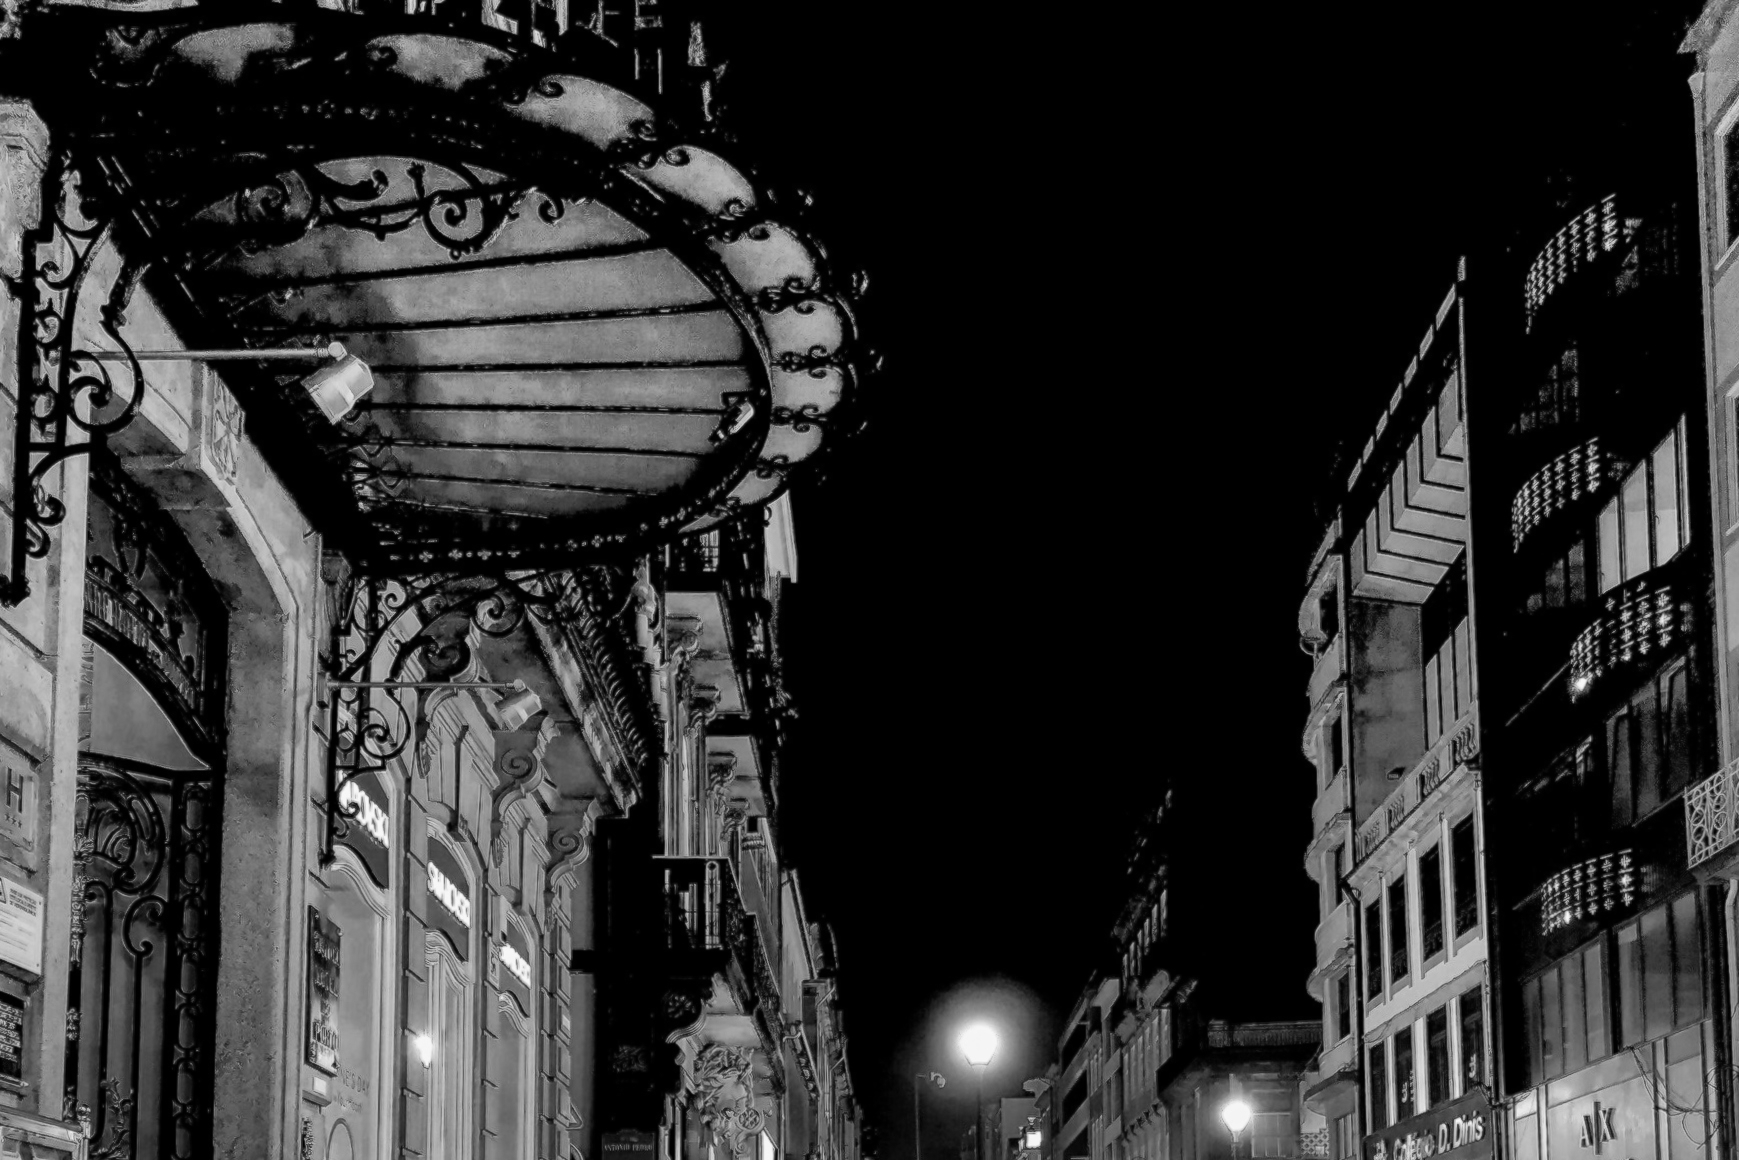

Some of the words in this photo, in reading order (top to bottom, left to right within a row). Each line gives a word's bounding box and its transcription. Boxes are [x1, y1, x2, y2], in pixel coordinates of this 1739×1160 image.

[6, 767, 23, 813] H
[1437, 1122, 1452, 1155] D.
[1452, 1109, 1485, 1149] Dinis
